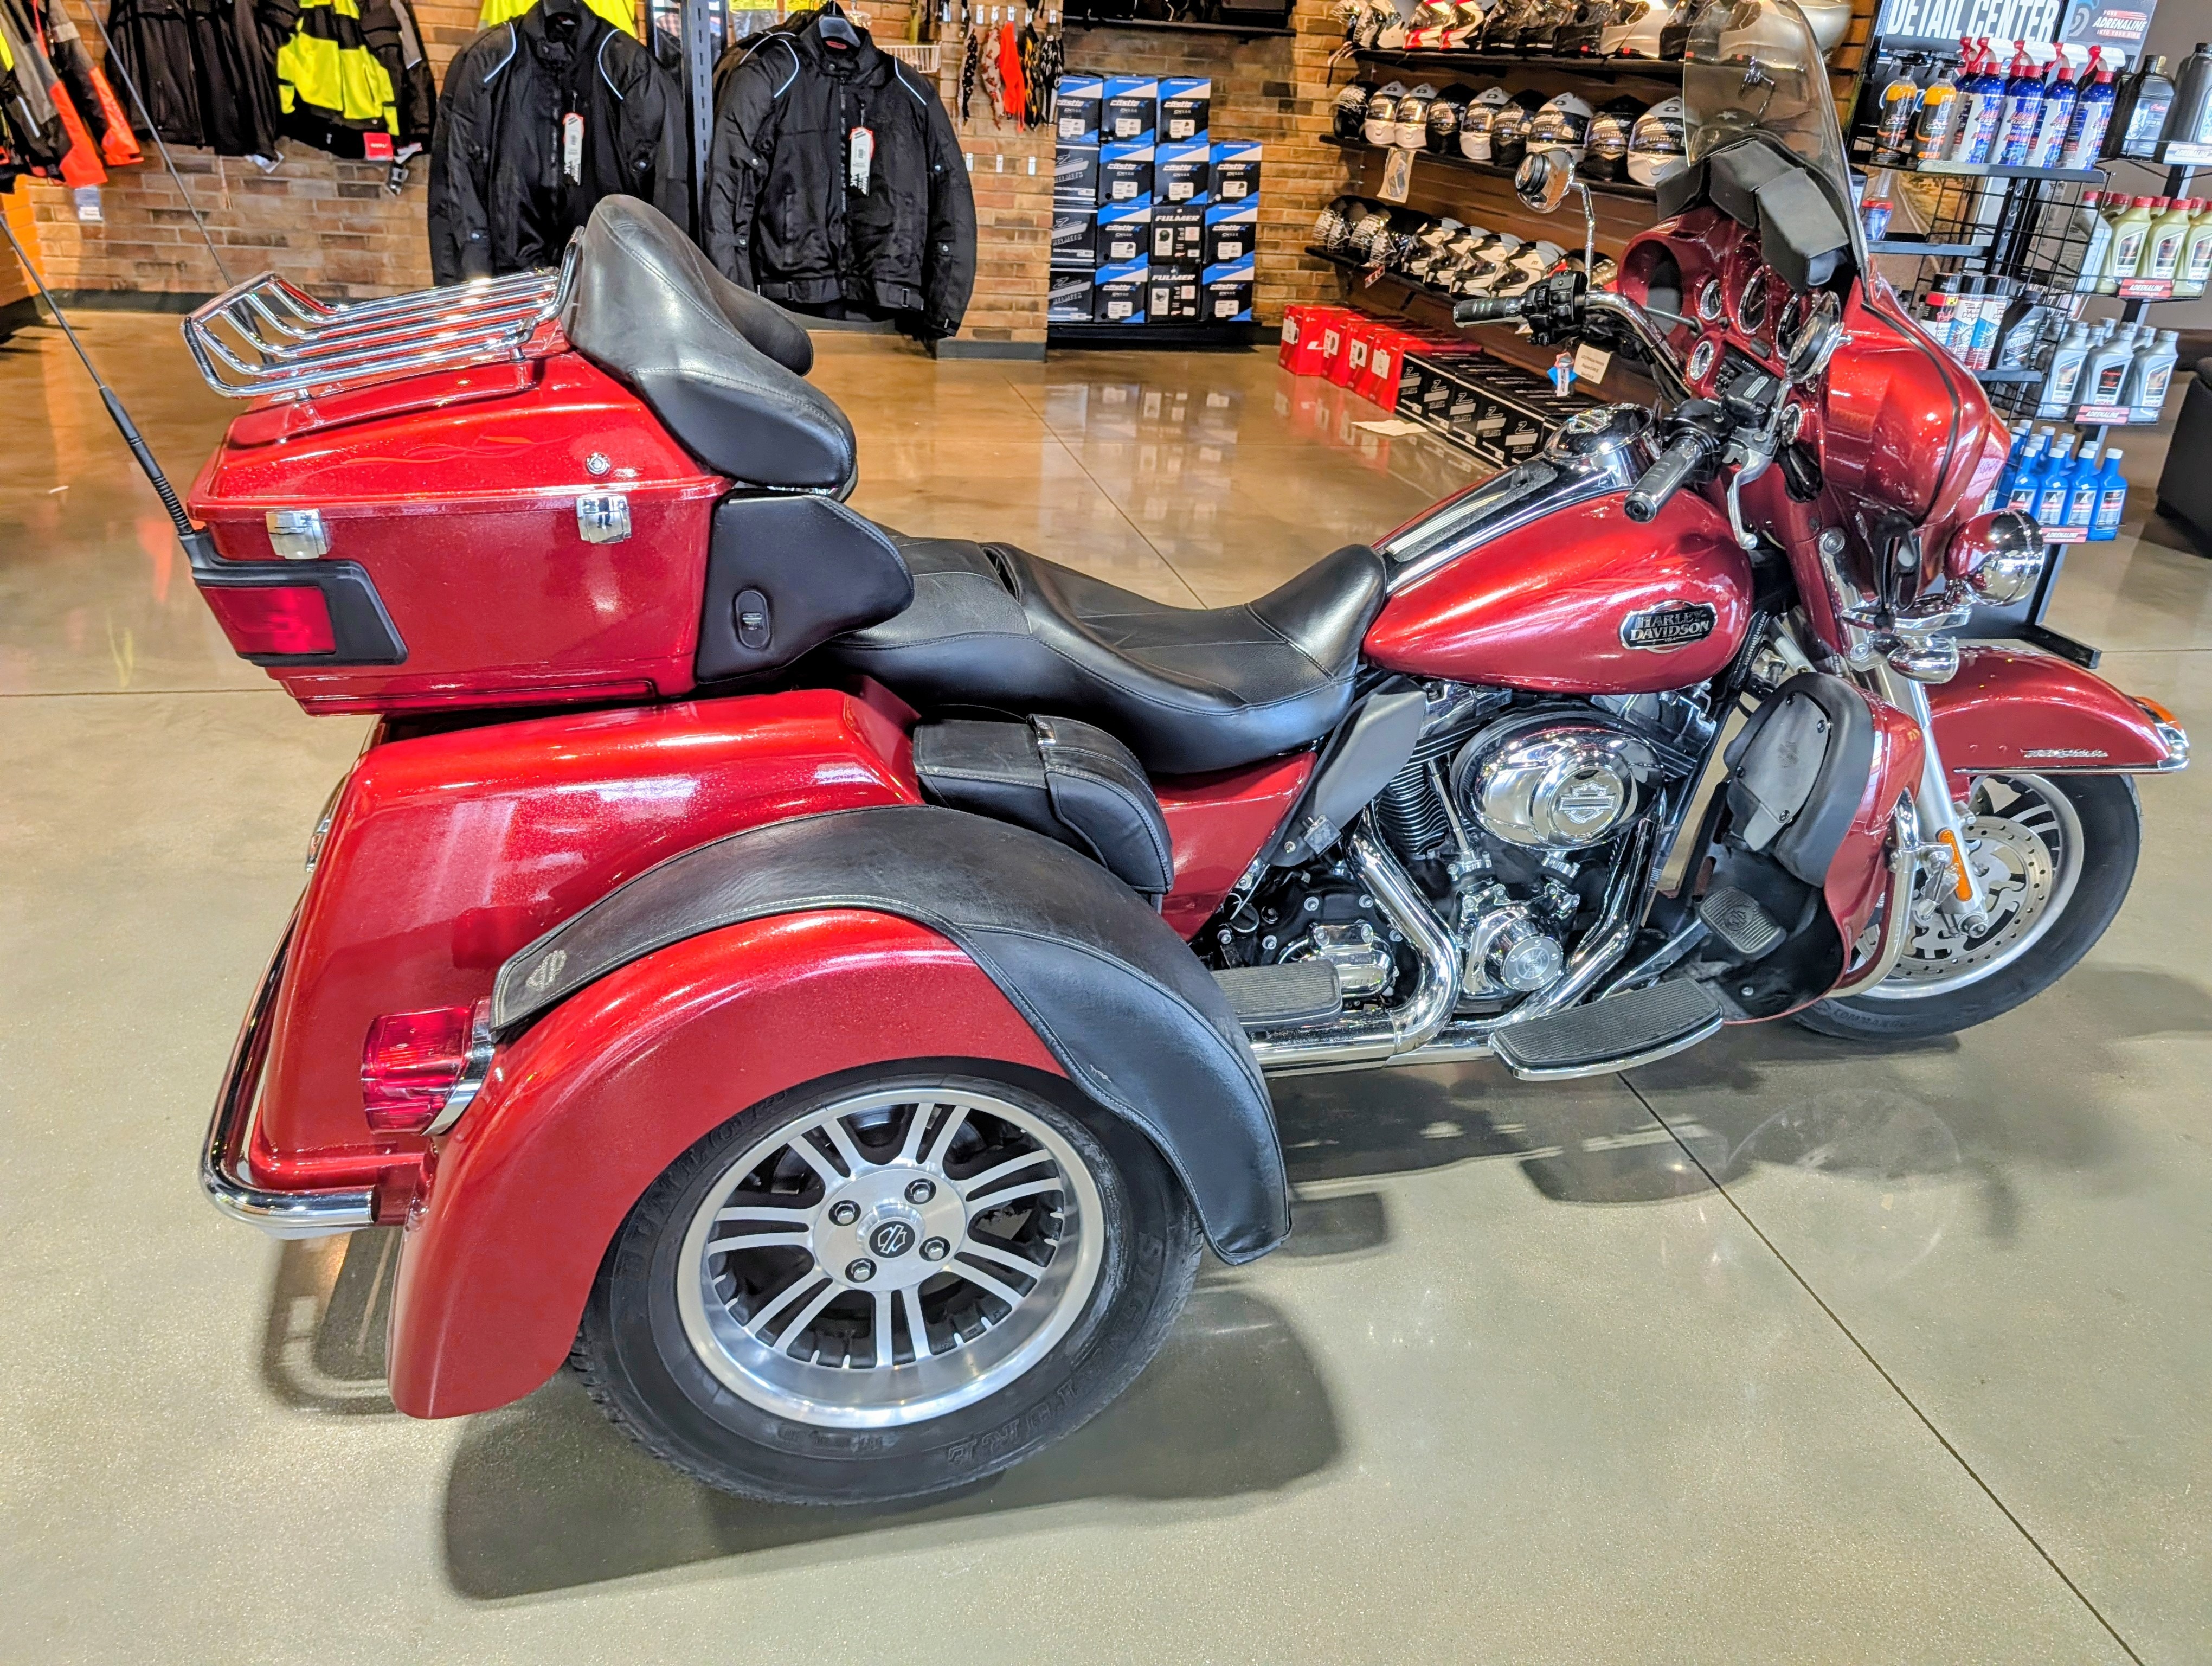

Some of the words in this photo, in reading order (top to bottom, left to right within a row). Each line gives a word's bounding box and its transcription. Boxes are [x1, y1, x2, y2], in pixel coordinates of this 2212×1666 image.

[1886, 0, 1964, 40] DETAIL
[1963, 0, 2059, 43] CENTER
[2092, 16, 2147, 31] ADRENALINE
[2129, 284, 2164, 292] ADRENALINE
[1630, 620, 1710, 641] DAVIDSON
[944, 1230, 1164, 1468] SIGNATURE
